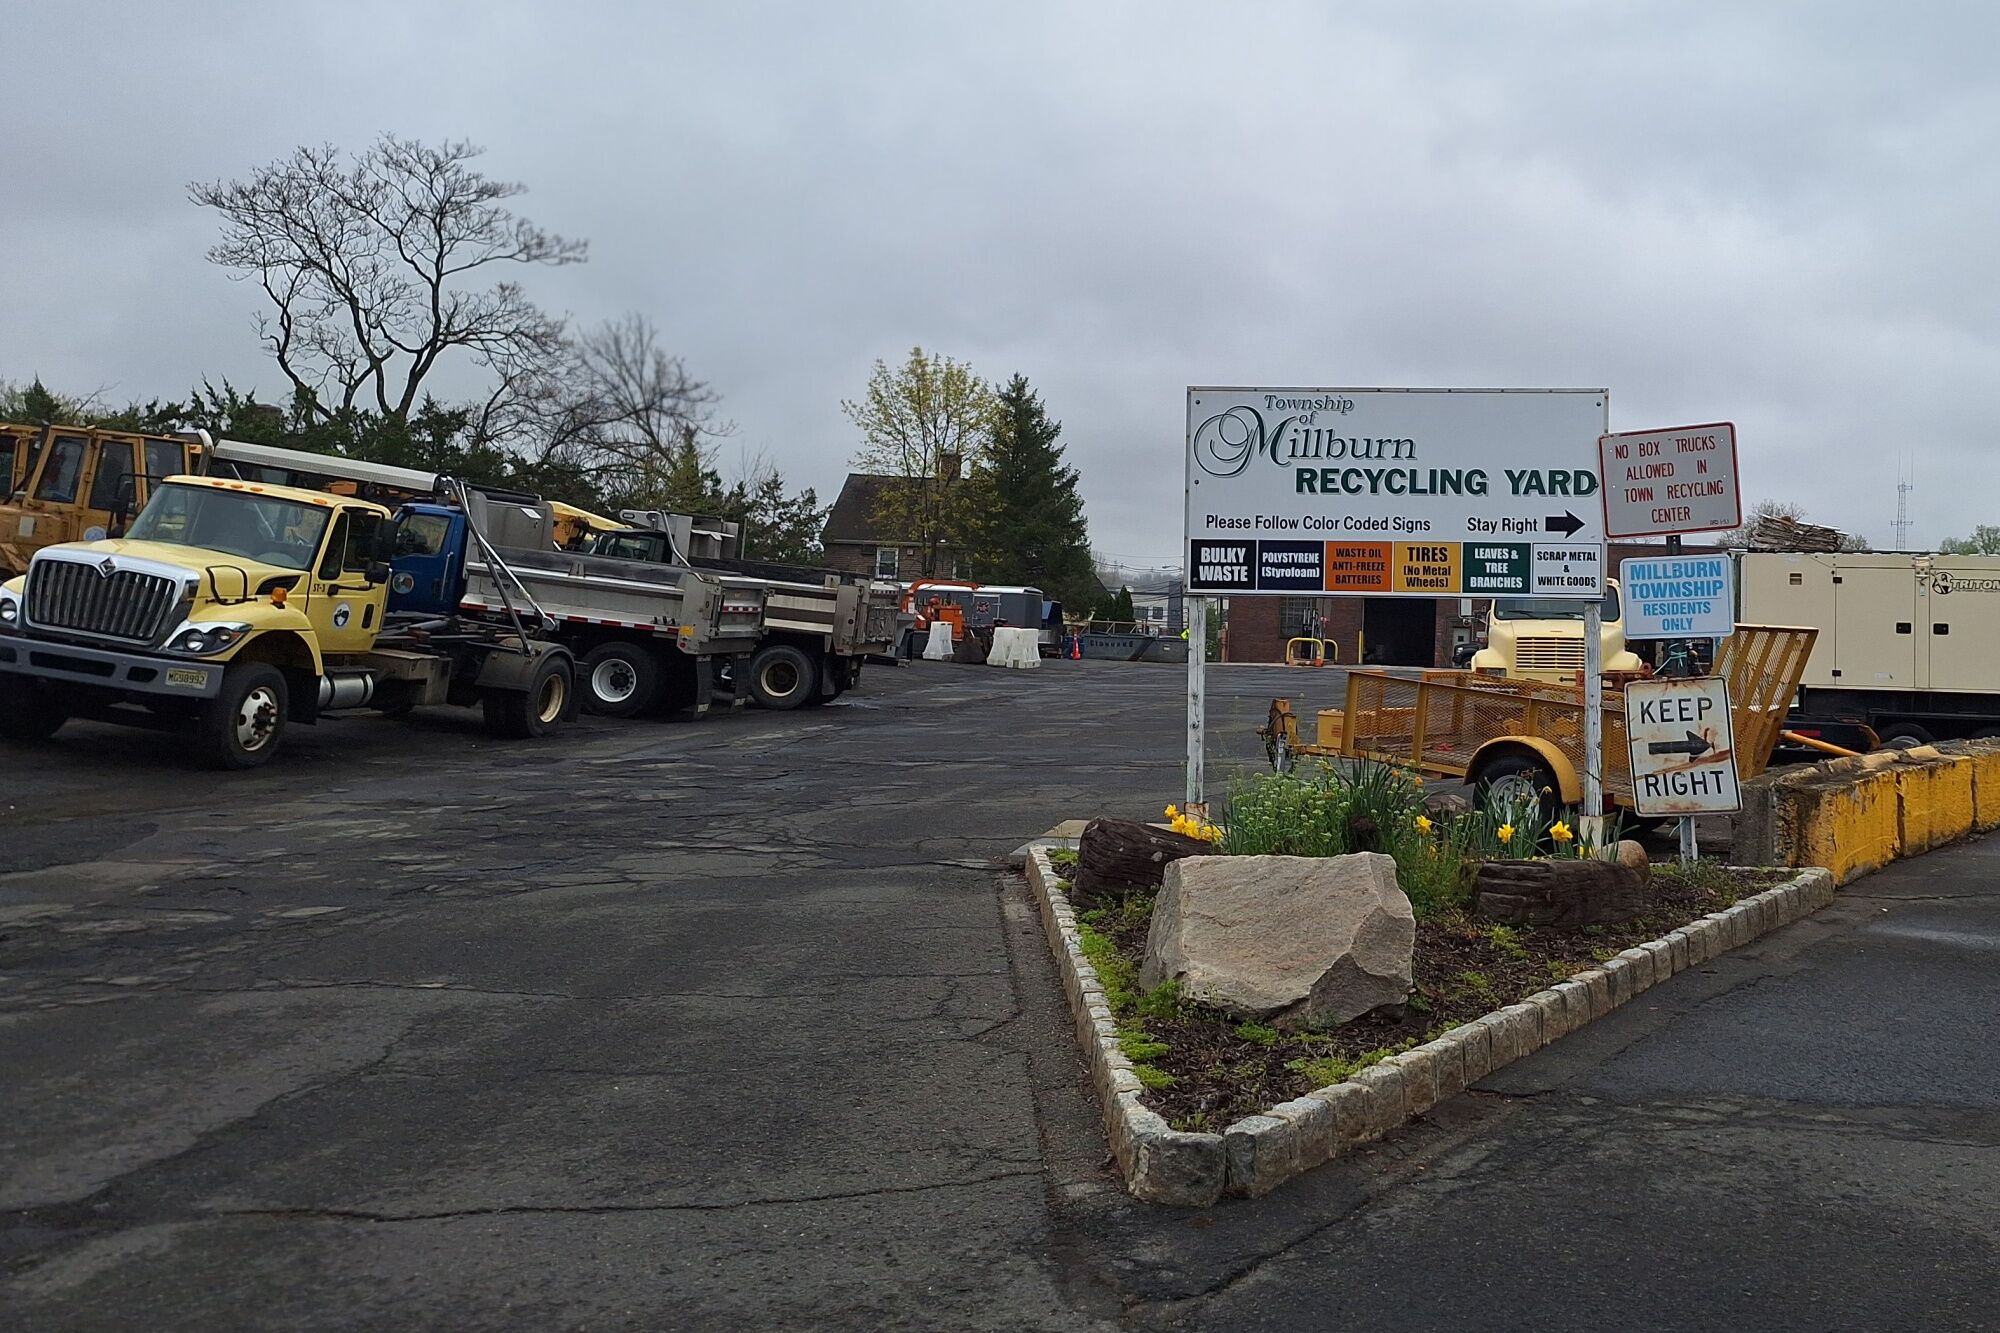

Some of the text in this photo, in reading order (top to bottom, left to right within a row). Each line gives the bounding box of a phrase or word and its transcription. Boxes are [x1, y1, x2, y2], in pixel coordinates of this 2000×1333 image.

[1264, 395, 1353, 414] Township
[1299, 411, 1318, 425] of
[1194, 405, 1417, 477] Millburn
[1615, 435, 1716, 459] NO BOX TRUCKS
[1626, 459, 1707, 481] ALLOWED IN
[1296, 468, 1597, 497] RECYCLING YARD
[1624, 480, 1724, 503] TOWN RECYCLING
[1652, 506, 1691, 524] CENTER
[1206, 514, 1431, 533] Please Follow Color Coded Signs
[1467, 517, 1538, 534] Stay Right
[1201, 547, 1246, 563] BULKY
[1262, 552, 1319, 564] POLYSTYRENE
[1335, 548, 1382, 558] WASTE OIL
[1407, 547, 1447, 562] TIRES
[1474, 548, 1519, 560] LEAVES &
[1537, 551, 1597, 562] SCRAP METAL
[1199, 565, 1248, 582] WASTE
[1262, 567, 1320, 578] (Styrofoam)
[1332, 562, 1385, 571] ANTI-FREEZE
[1403, 566, 1451, 576] (No Metal
[1485, 562, 1508, 574] TREE
[1563, 564, 1570, 573] &
[1630, 561, 1722, 581] MILLBURN
[1335, 575, 1381, 584] BATTERIES
[1406, 576, 1448, 588] Wheels)
[1470, 577, 1523, 588] BRANCHES
[1538, 577, 1596, 588] WHITE GOODS
[1629, 580, 1724, 599] TOWNSHIP
[1643, 601, 1711, 616] RESIDENTS
[1662, 618, 1693, 631] ONLY
[1640, 697, 1713, 724] KEEP
[1644, 770, 1724, 797] RIGHT
